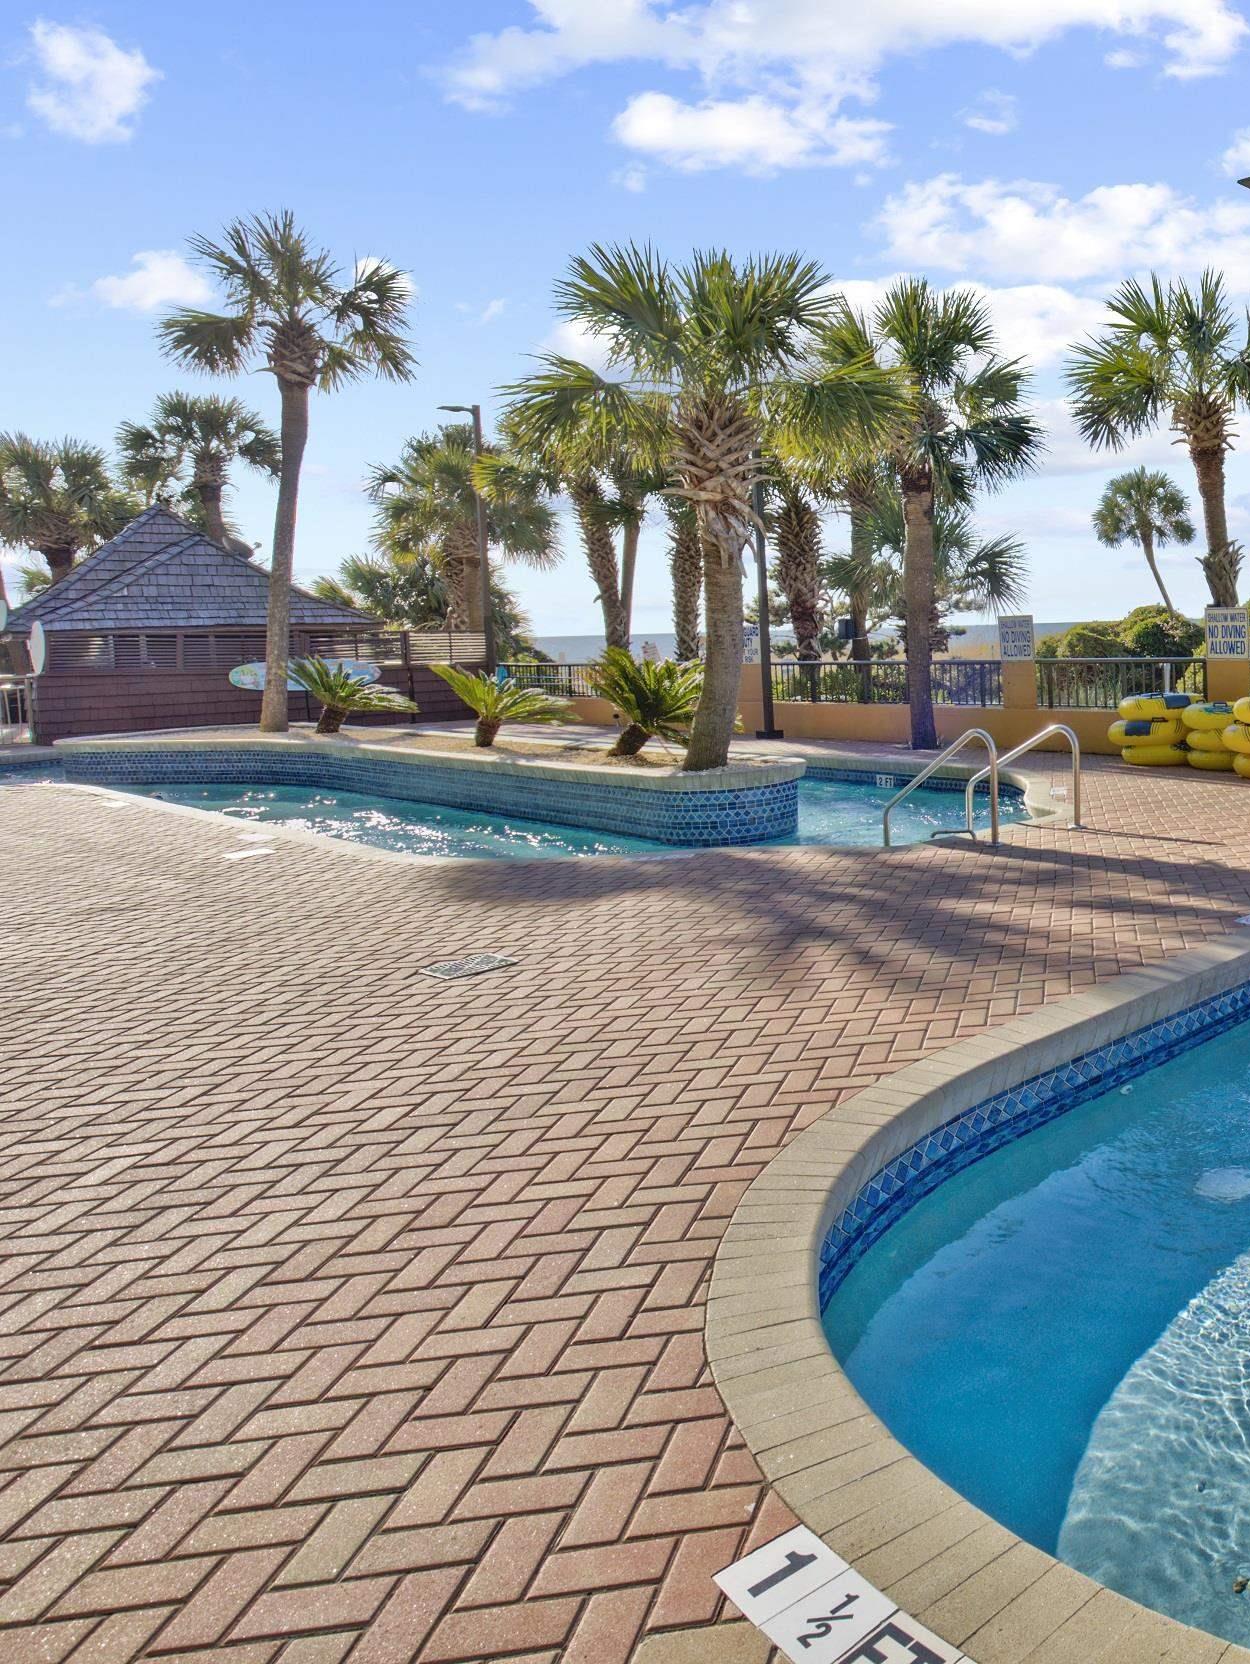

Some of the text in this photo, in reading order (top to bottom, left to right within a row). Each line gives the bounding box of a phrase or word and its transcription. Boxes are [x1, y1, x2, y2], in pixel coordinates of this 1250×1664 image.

[1230, 613, 1246, 622] WATER
[1002, 631, 1031, 643] NO DIVING
[1208, 625, 1246, 639] NO DIVING
[1003, 644, 1031, 657] ALLOWED
[1210, 640, 1246, 655] ALLOWED
[879, 776, 893, 787] 2 FT
[747, 1550, 818, 1599] 1
